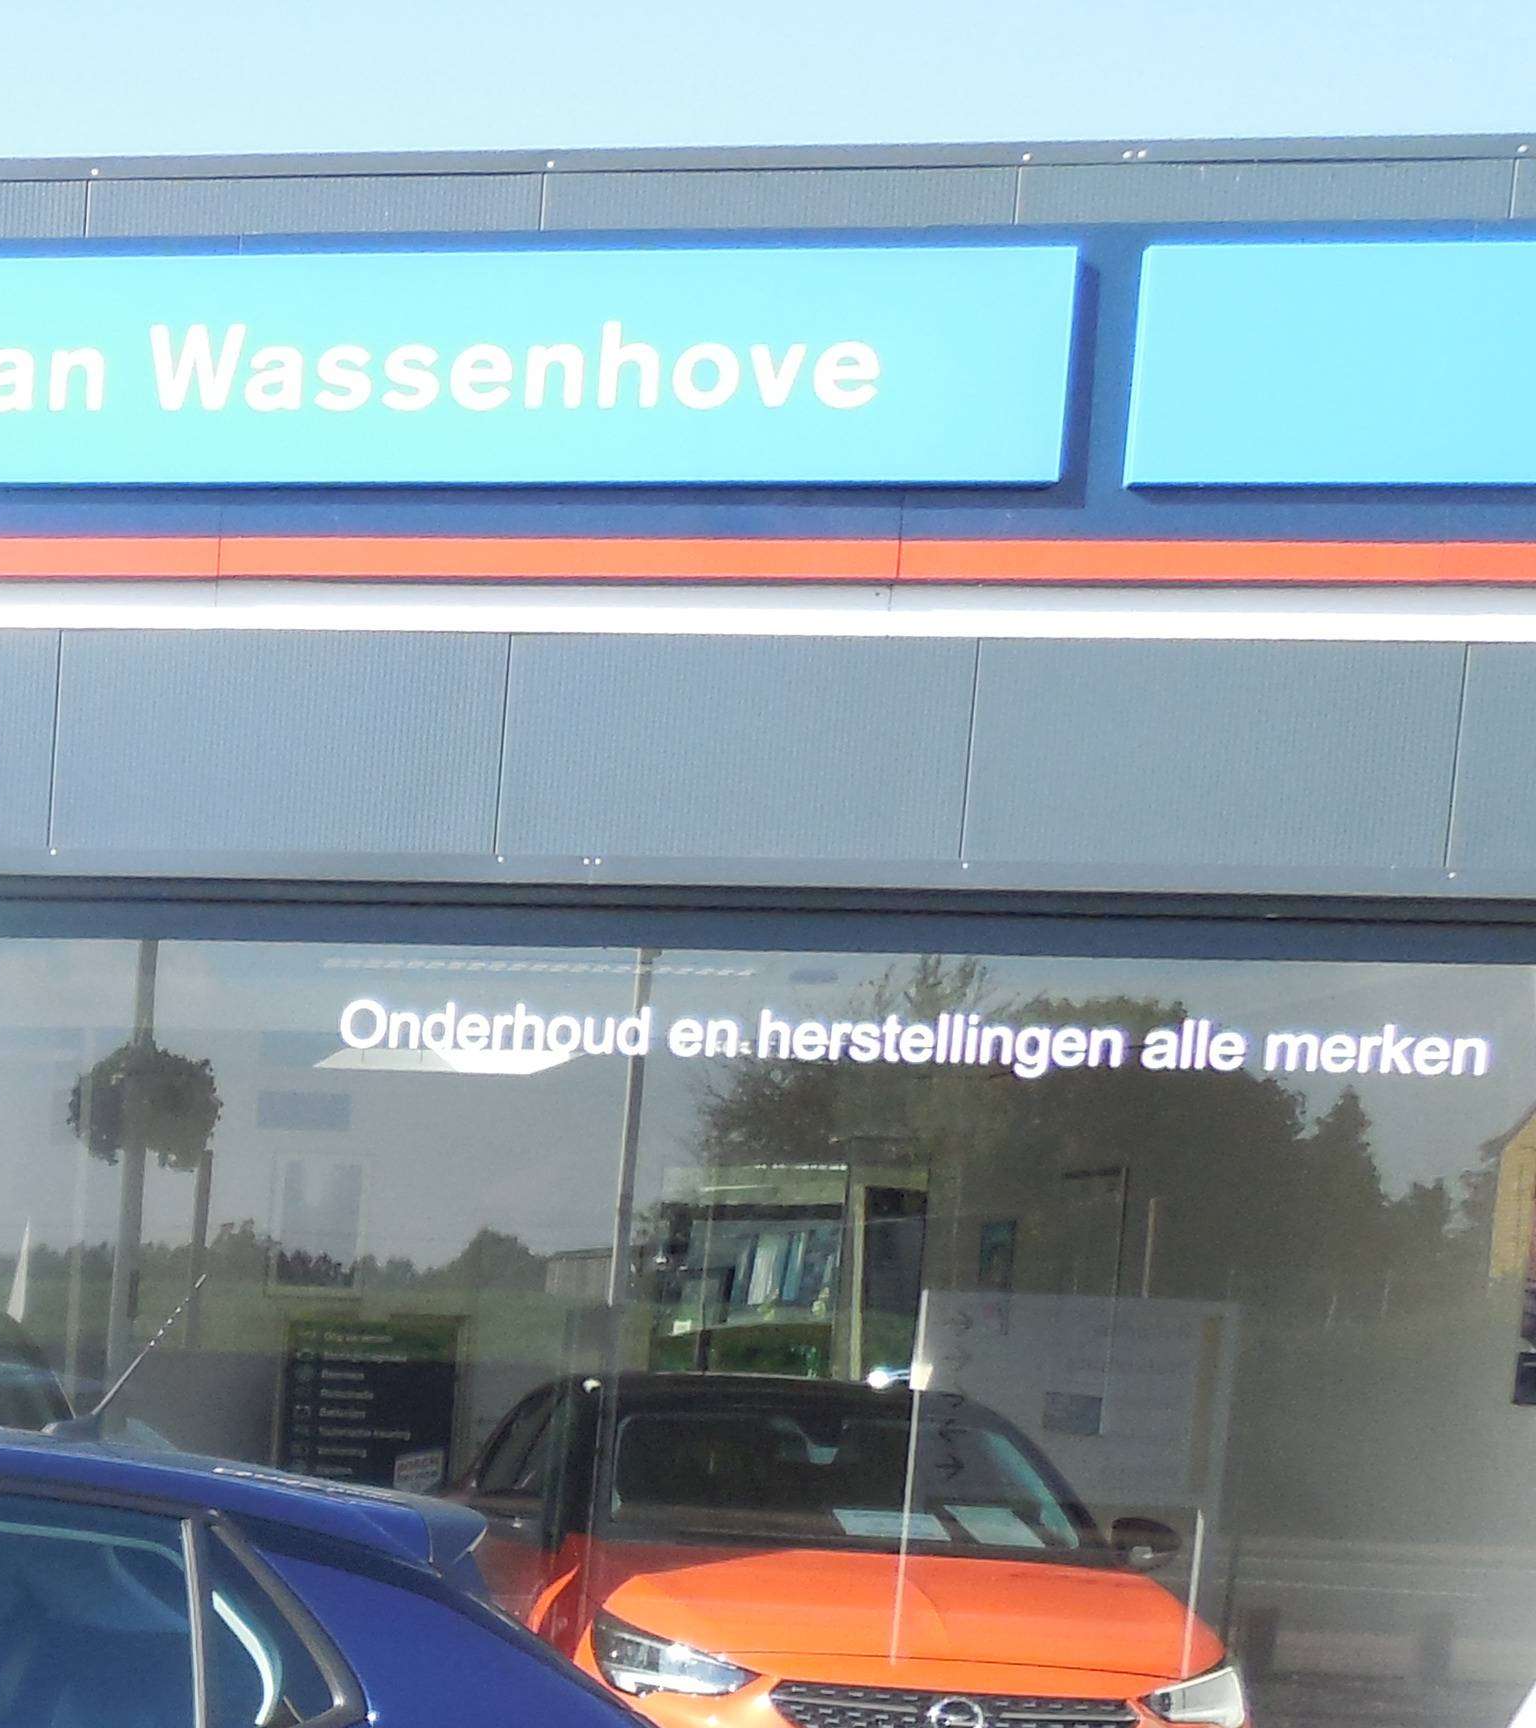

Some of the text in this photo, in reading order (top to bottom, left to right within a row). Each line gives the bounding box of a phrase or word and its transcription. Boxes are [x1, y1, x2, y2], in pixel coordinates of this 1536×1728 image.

[148, 320, 883, 413] Wassenhove
[339, 998, 1490, 1080] Onderhoud en herstellingen alle merken
